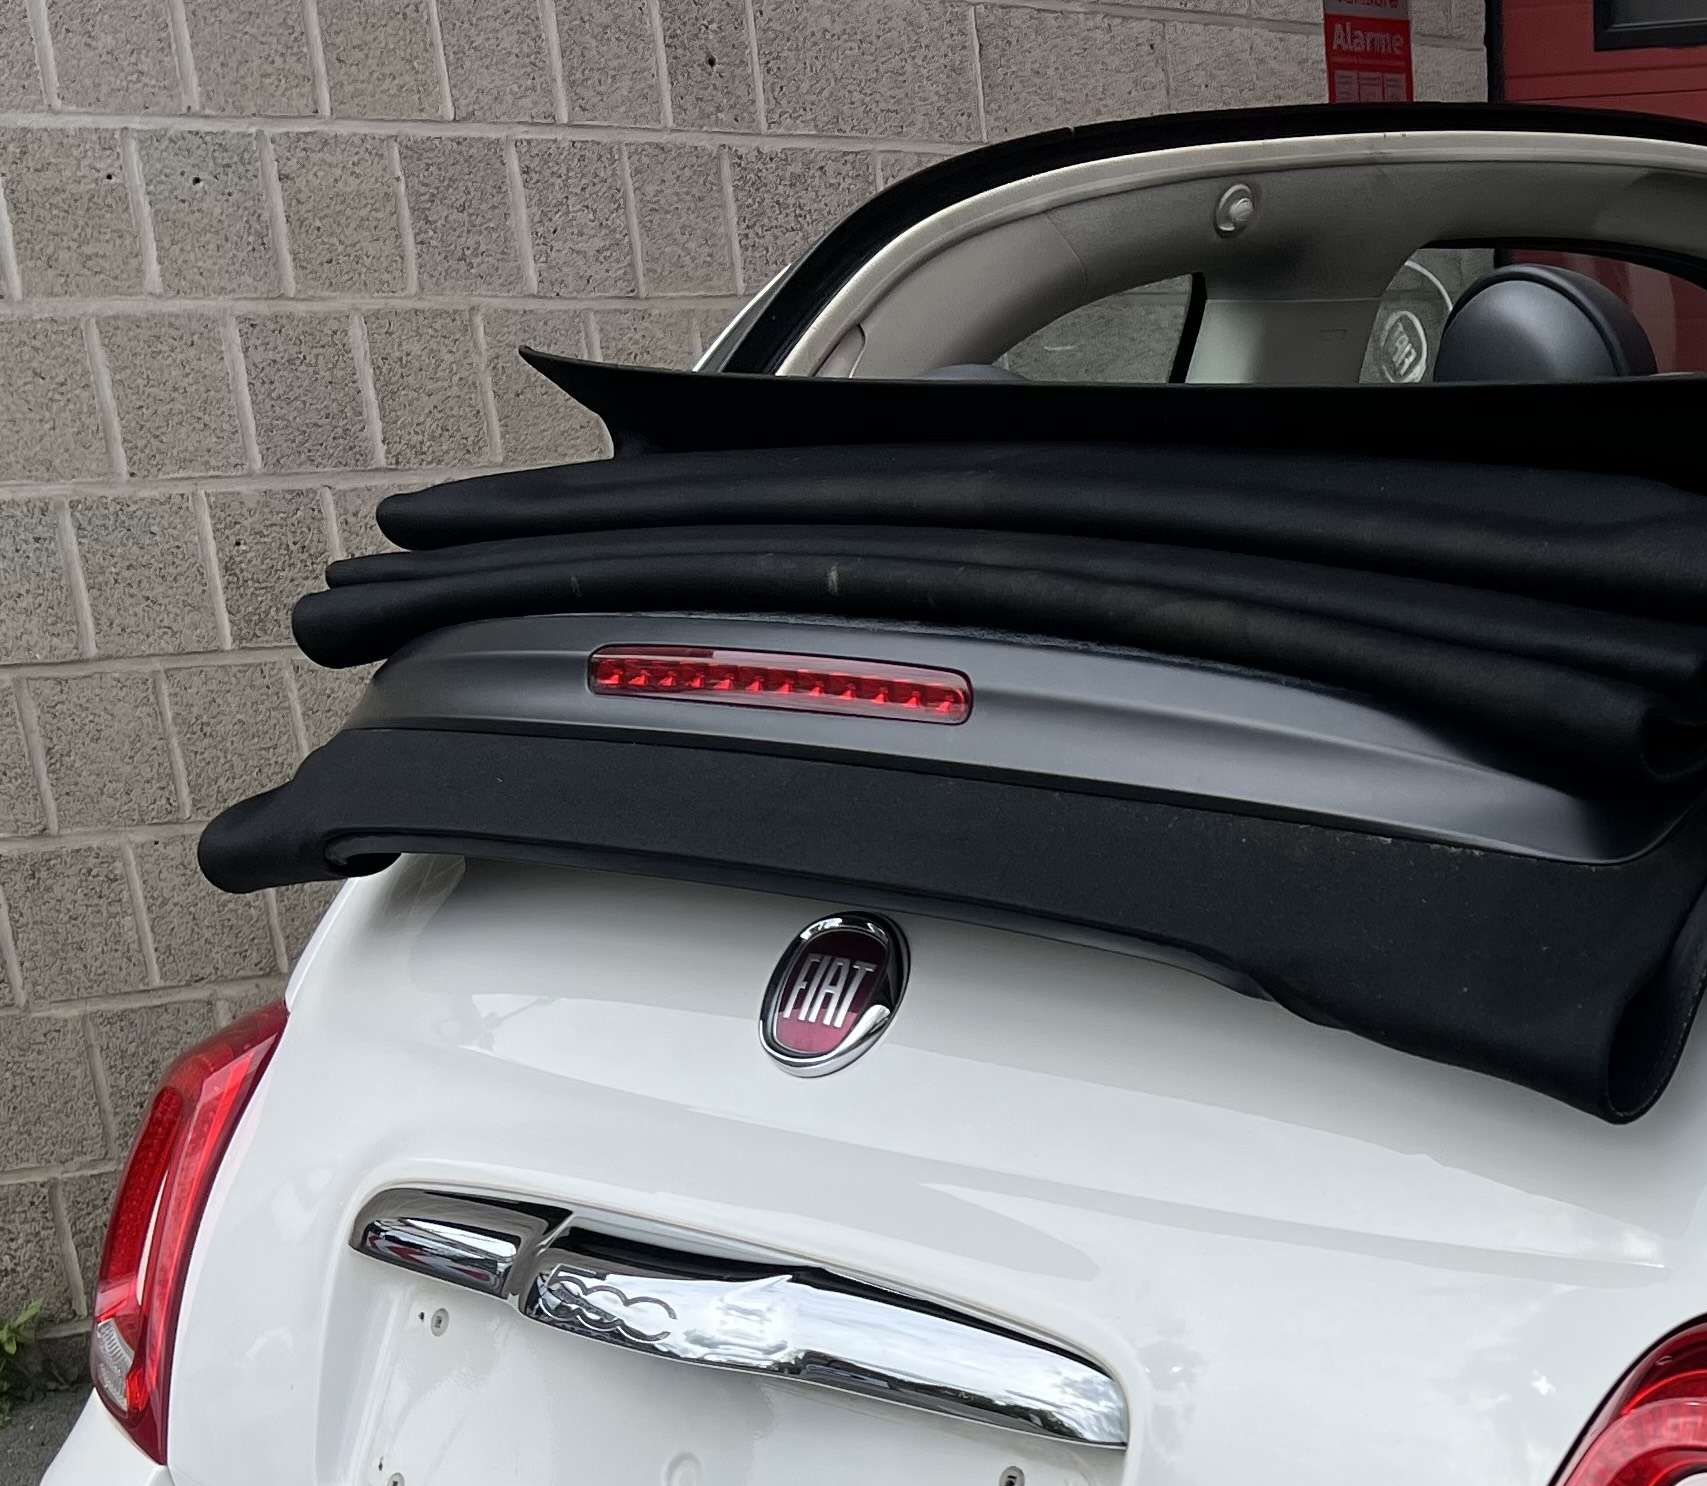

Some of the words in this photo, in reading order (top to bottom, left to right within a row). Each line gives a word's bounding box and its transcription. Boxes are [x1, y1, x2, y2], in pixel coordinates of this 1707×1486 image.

[1332, 22, 1405, 55] Alarme
[783, 953, 877, 1028] FIAT
[538, 1263, 677, 1345] 500
